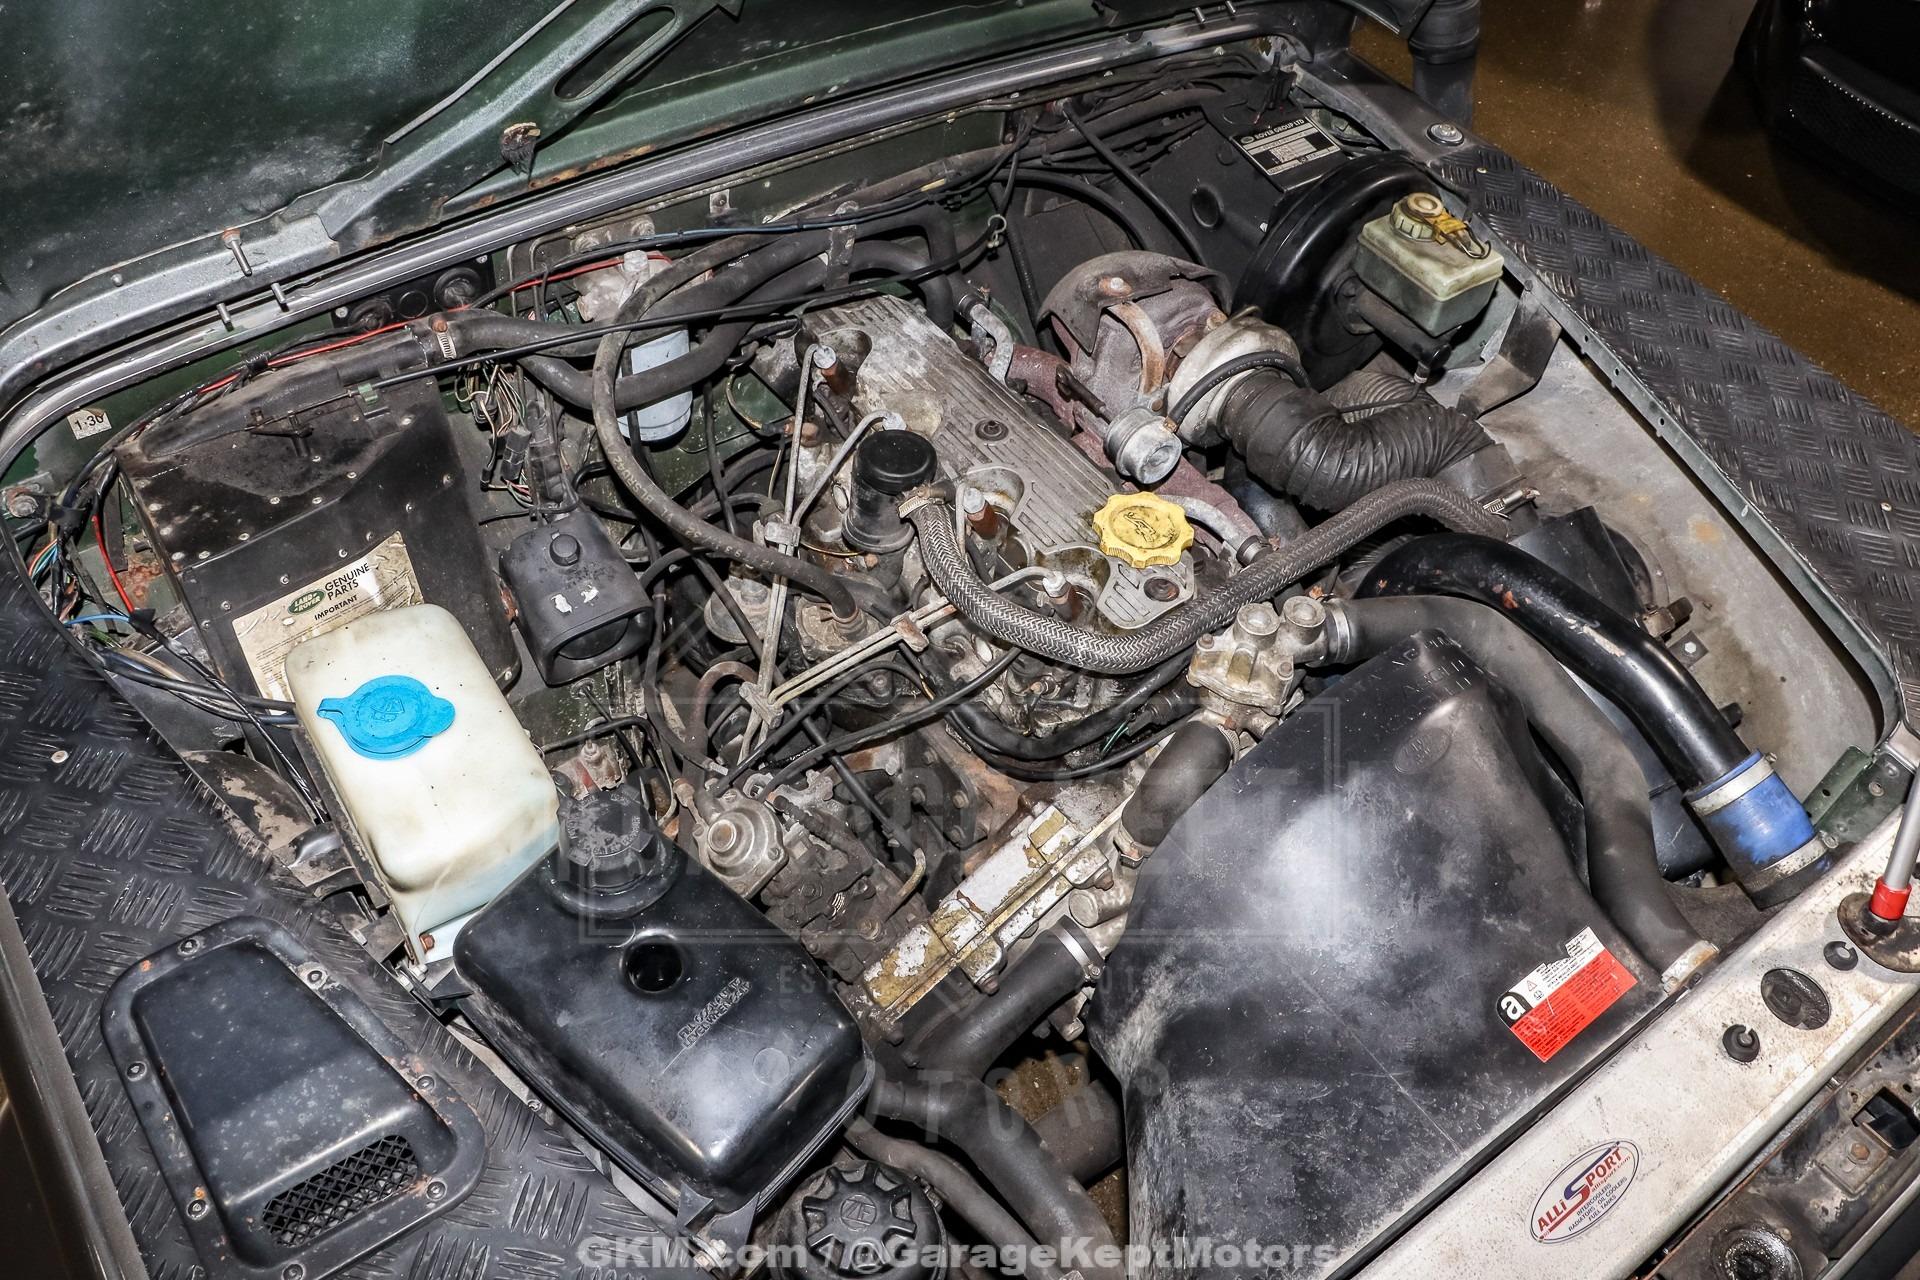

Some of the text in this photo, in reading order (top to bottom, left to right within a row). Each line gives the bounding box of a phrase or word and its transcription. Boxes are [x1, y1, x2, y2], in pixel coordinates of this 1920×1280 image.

[325, 562, 370, 592] GENUINE
[327, 579, 359, 601] PARTS
[294, 593, 315, 608] LAND
[298, 596, 321, 612] ROVER
[314, 594, 359, 621] IMPORTANT
[1500, 995, 1527, 1020] a
[1568, 1176, 1628, 1232] RADIATORS OIL COOLERS
[1576, 1183, 1612, 1216] INTERCOOLERS
[1588, 1194, 1617, 1222] FUEL TANKS
